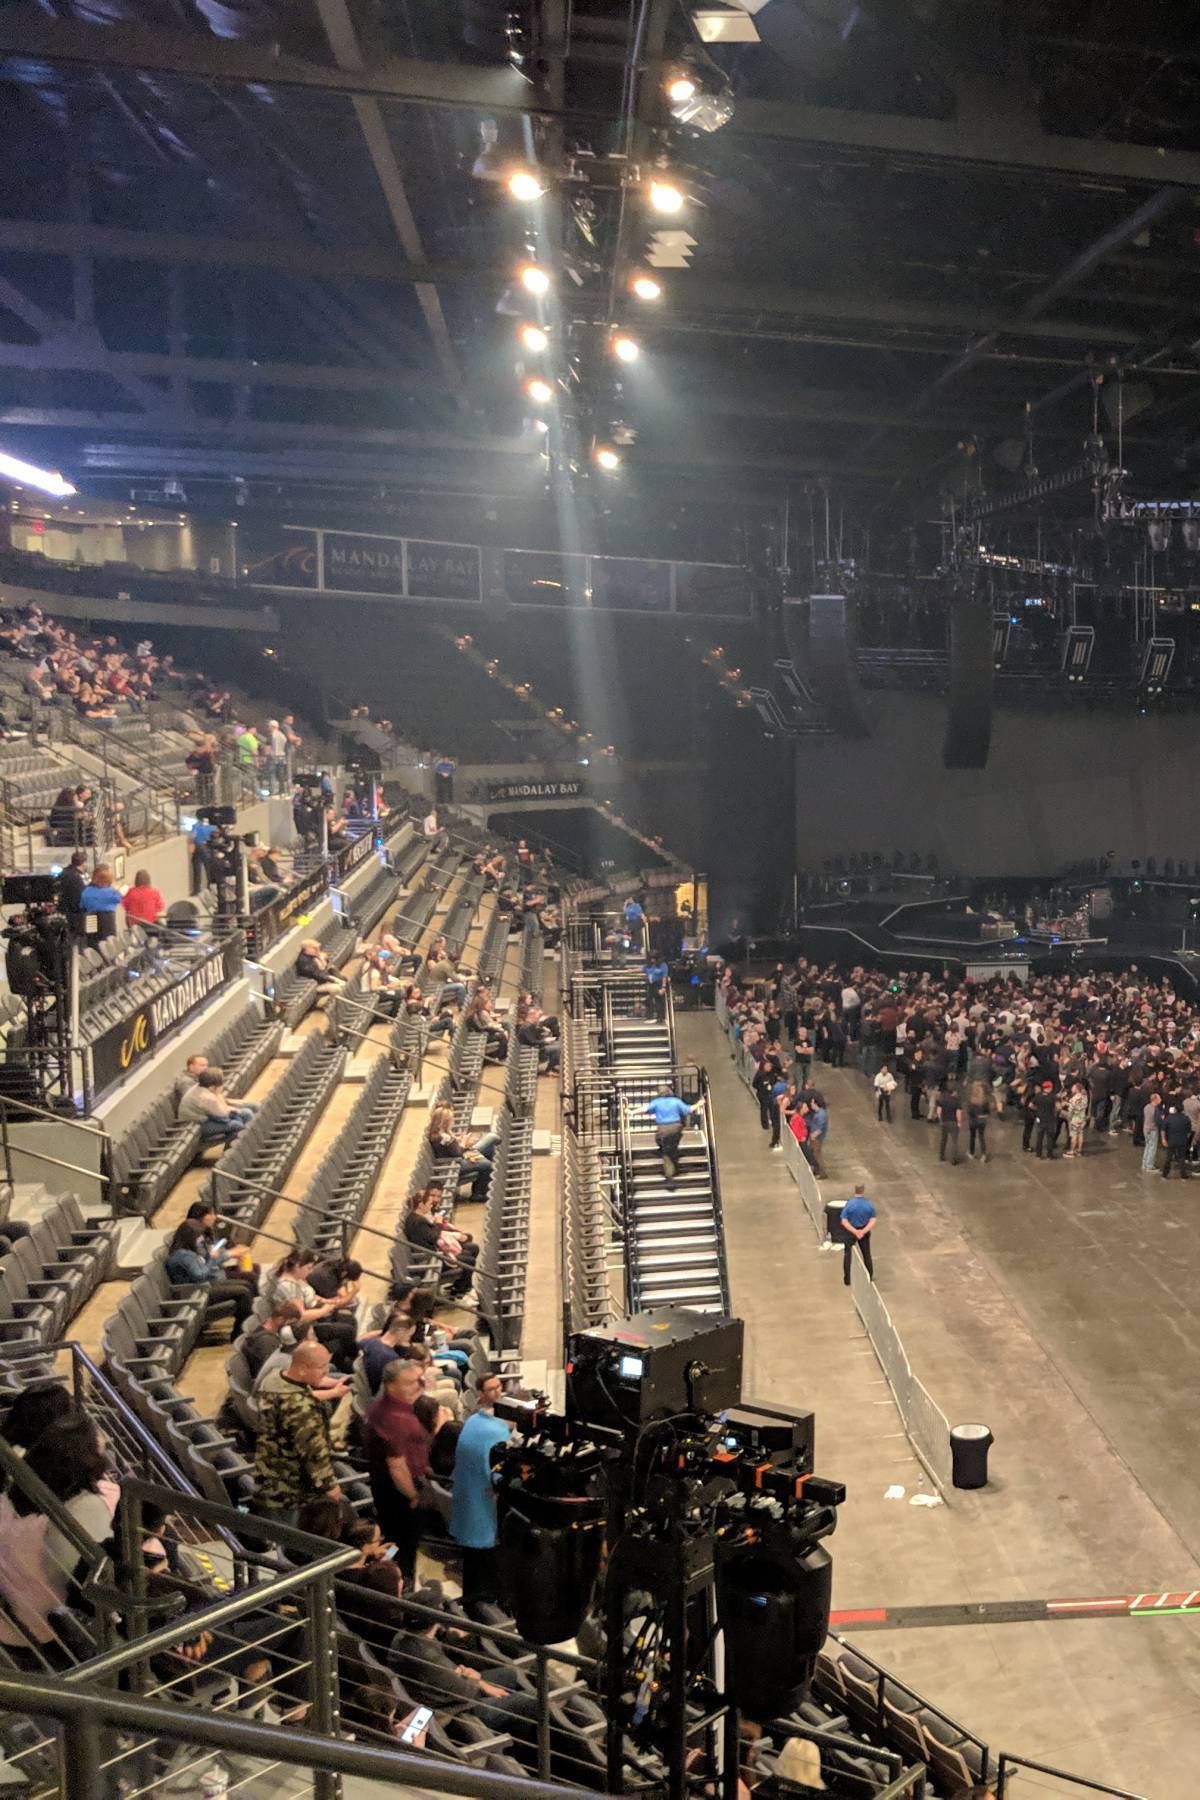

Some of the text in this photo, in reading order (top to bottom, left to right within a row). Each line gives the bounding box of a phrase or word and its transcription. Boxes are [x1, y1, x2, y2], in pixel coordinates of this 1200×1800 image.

[560, 783, 578, 793] BAY
[152, 952, 225, 1036] MANDALAY BAY
